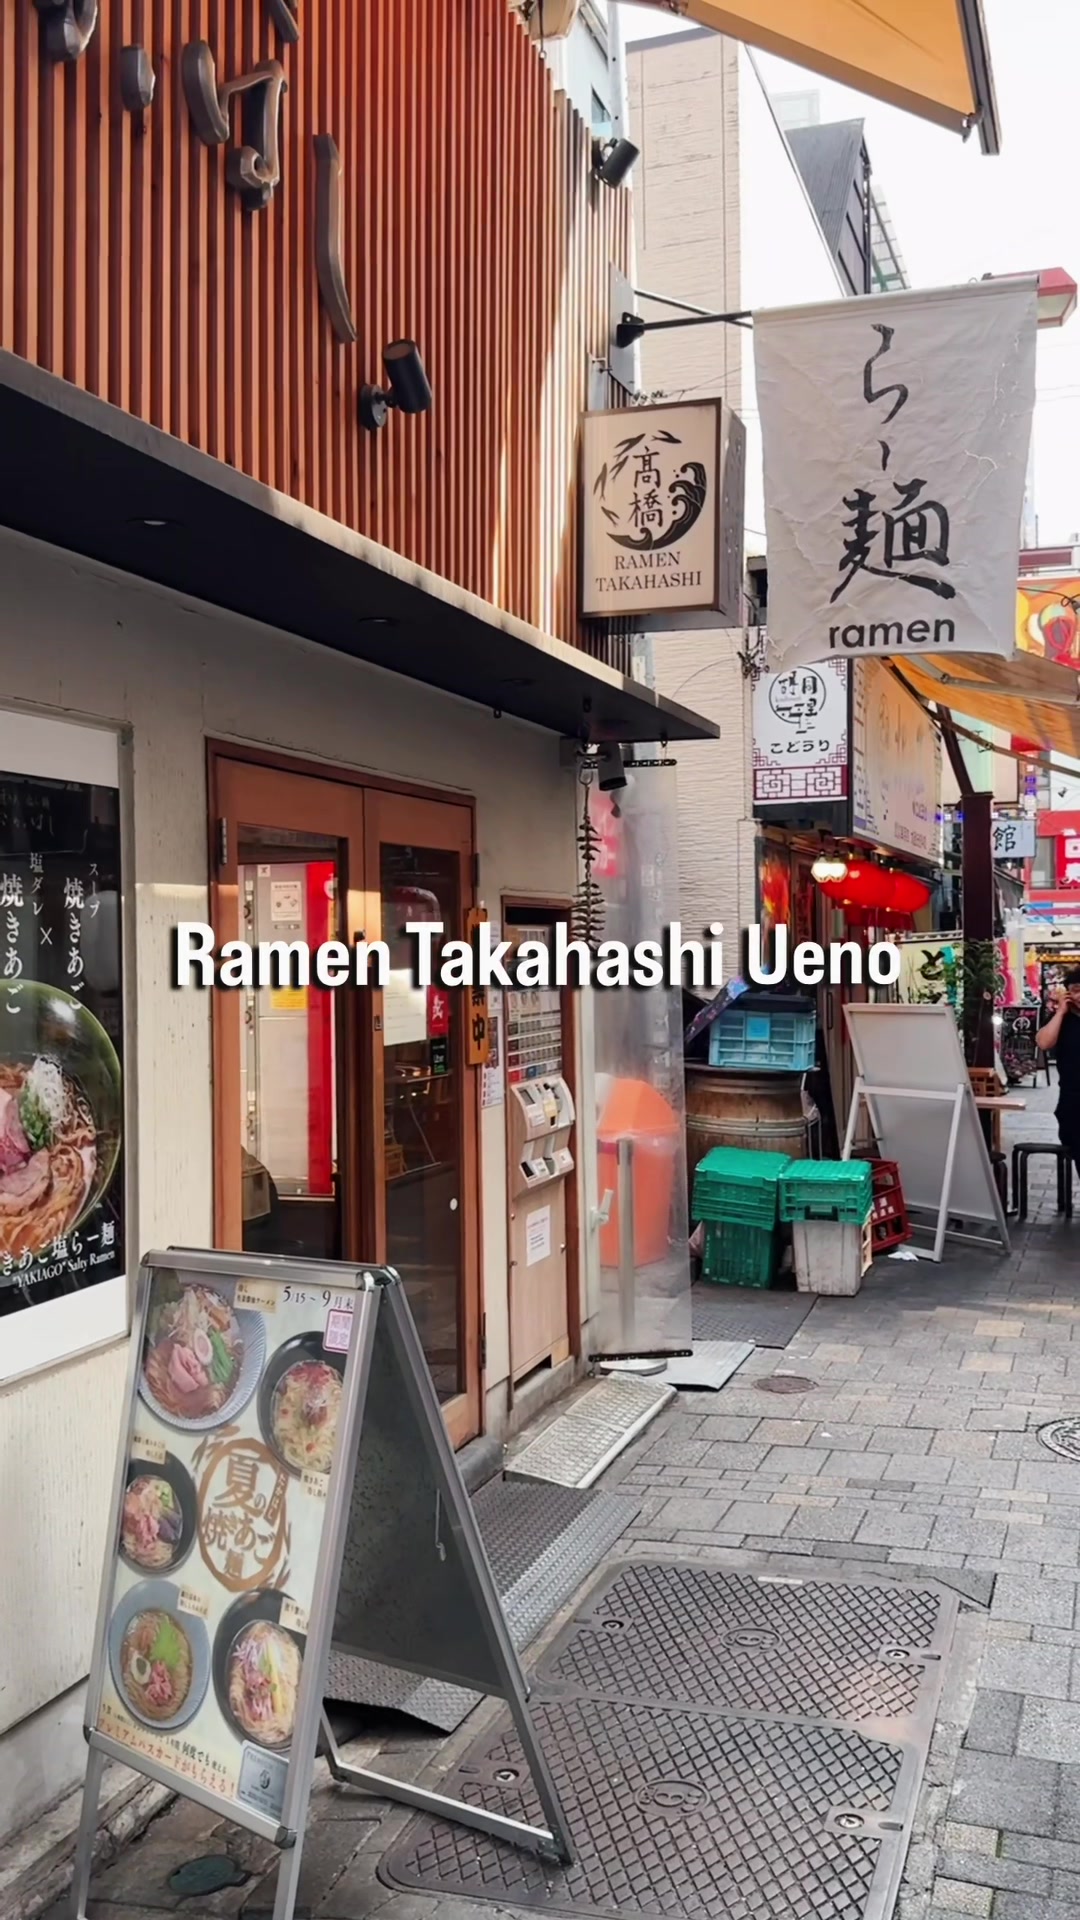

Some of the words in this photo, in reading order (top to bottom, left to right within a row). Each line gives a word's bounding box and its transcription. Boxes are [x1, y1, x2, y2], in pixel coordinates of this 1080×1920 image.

[829, 323, 957, 604] らー麺
[596, 570, 702, 592] TAKAHASHI
[614, 551, 681, 571] RAMEN
[829, 615, 956, 650] ramen
[770, 739, 830, 754] こどうり
[29, 852, 44, 916] 塩ダレ
[89, 863, 101, 919] スープ
[0, 873, 25, 1014] 焼きあご
[63, 877, 86, 1010] 焼きあご
[2, 1219, 116, 1277] きあご塩らー麺
[67, 1257, 88, 1273] Salty
[89, 1249, 116, 1266] Ramen
